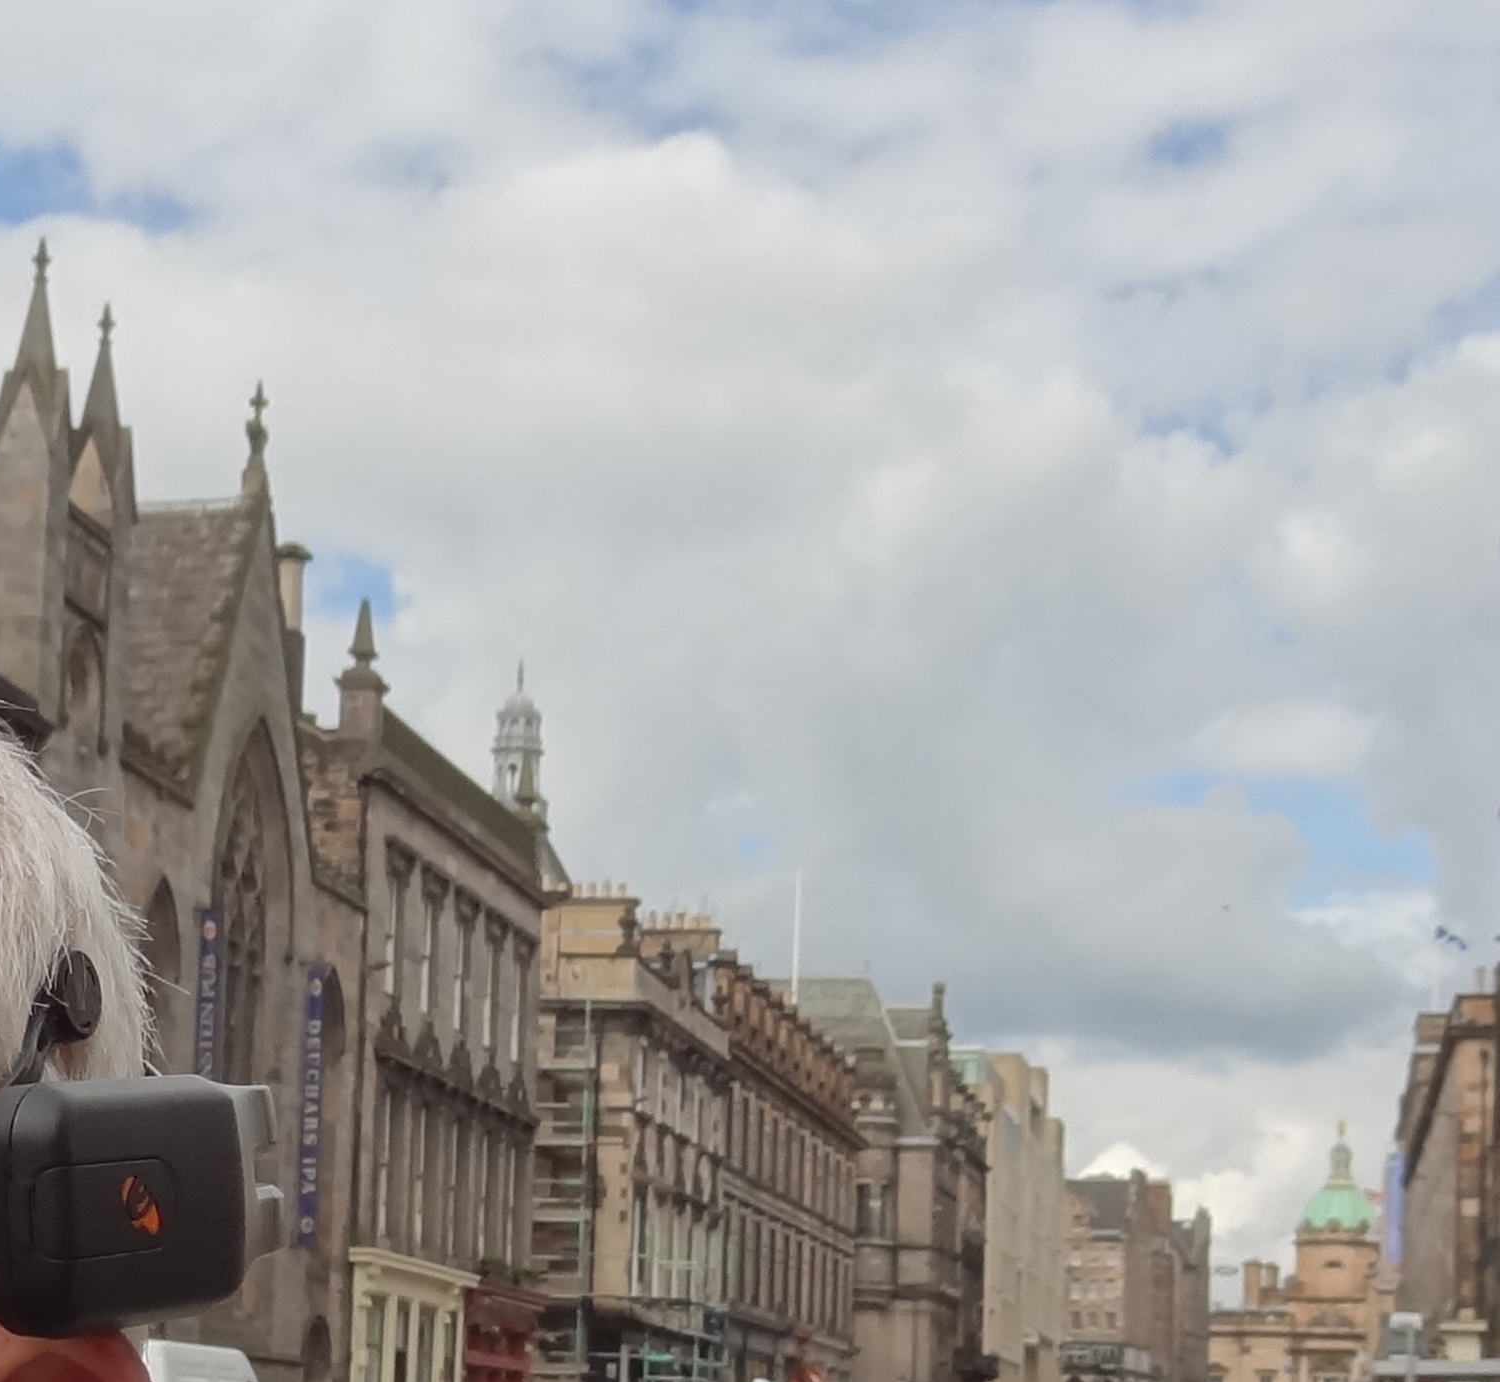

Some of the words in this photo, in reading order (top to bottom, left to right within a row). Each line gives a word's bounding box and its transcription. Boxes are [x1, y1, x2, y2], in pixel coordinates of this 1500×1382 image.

[201, 953, 217, 998] PUB
[303, 1020, 322, 1146] DEUCHARS
[301, 1157, 317, 1194] IPA
